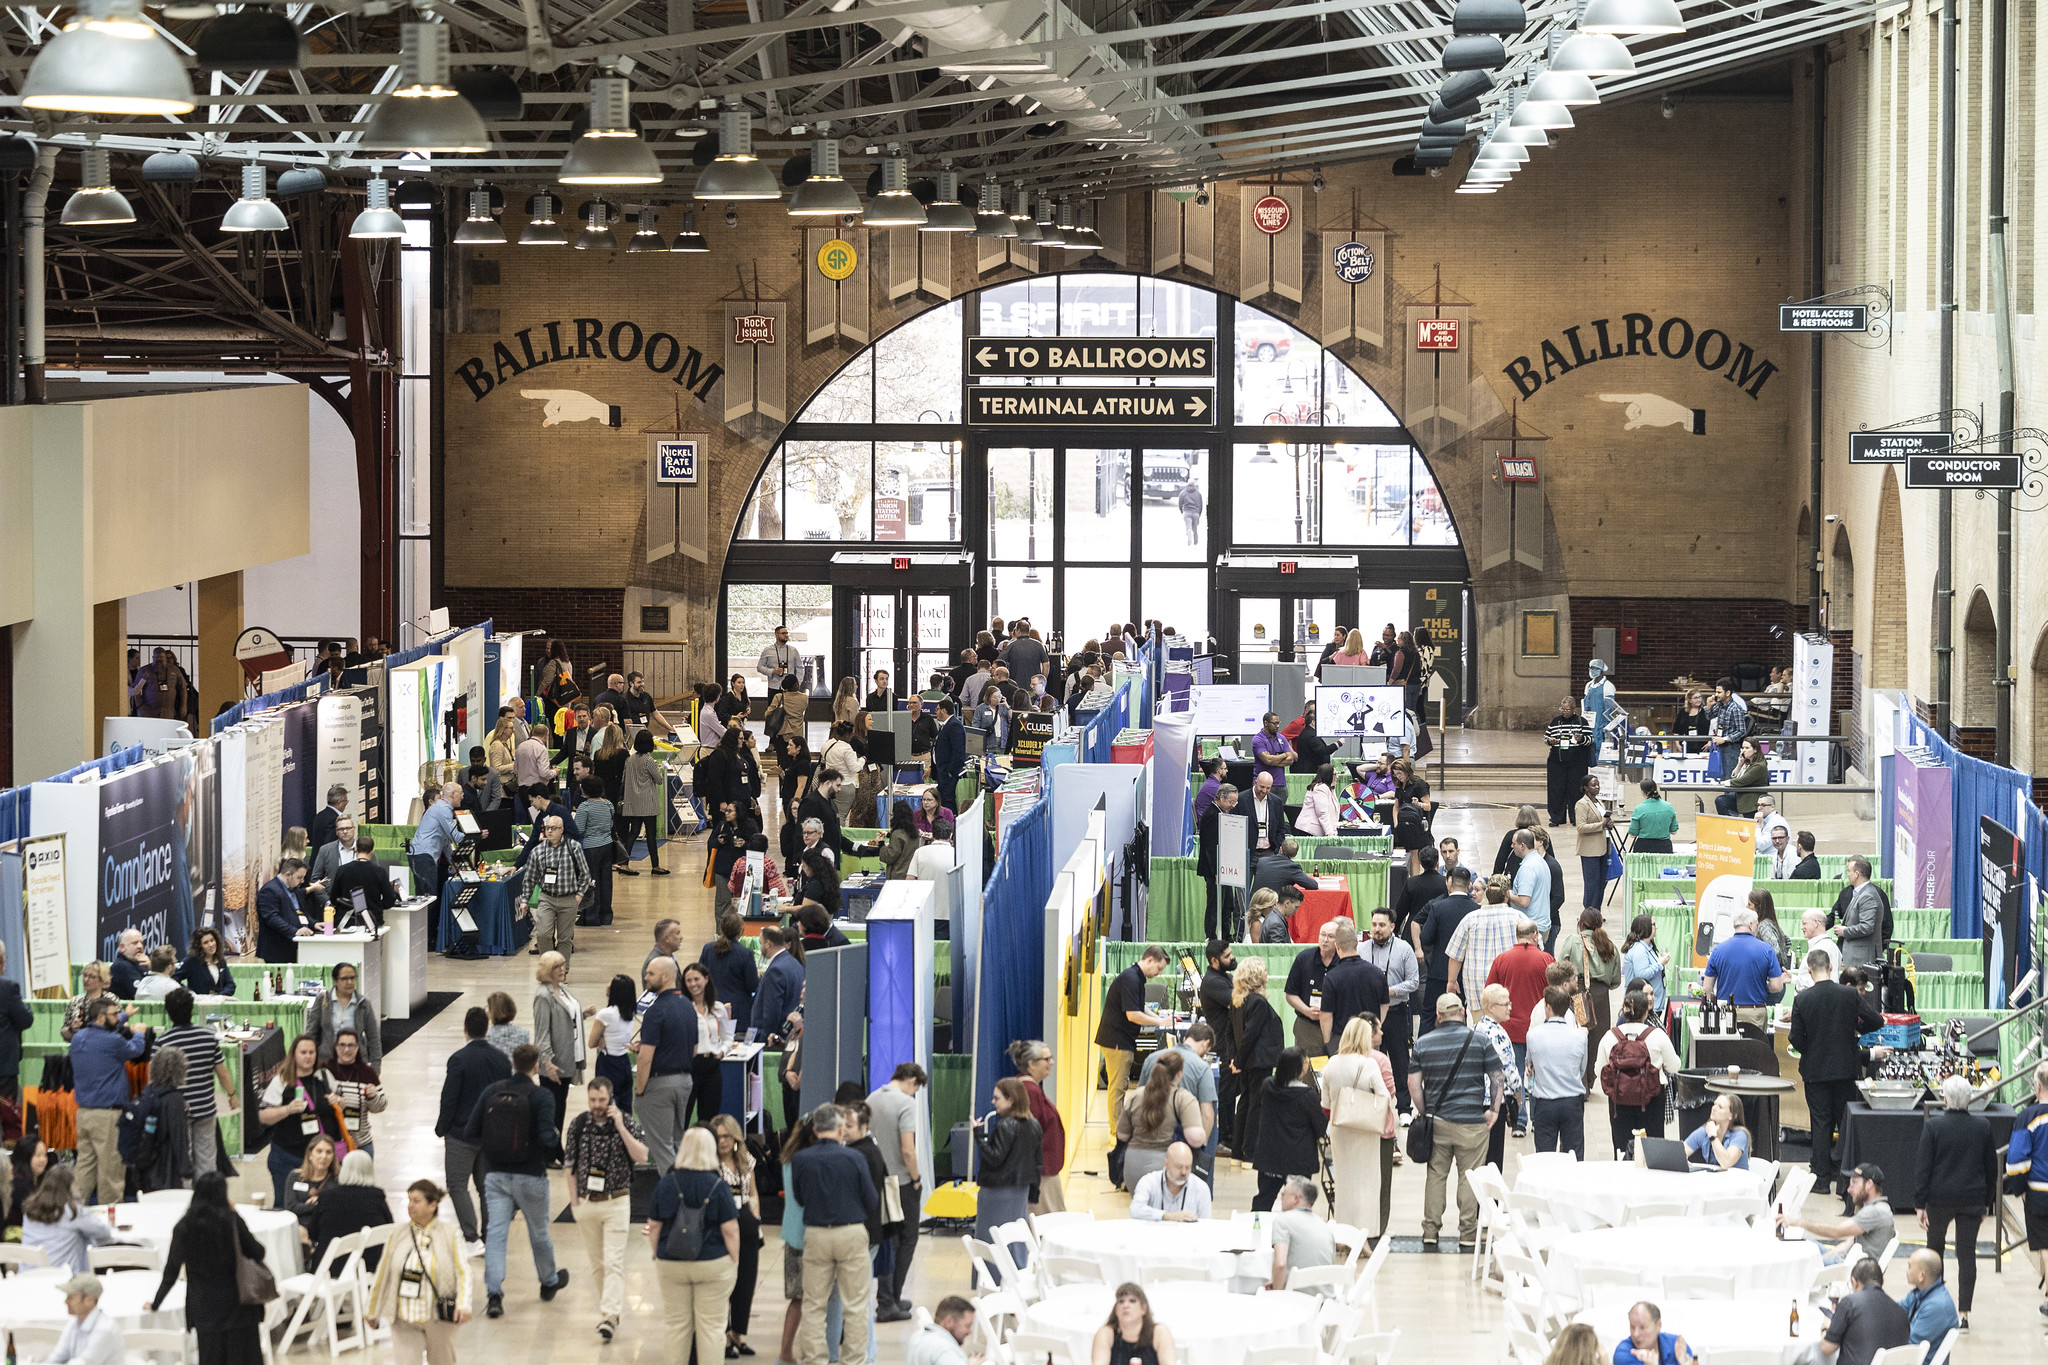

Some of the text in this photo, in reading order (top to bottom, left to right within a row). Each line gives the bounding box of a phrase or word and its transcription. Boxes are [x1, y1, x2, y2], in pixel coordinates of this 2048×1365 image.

[827, 249, 848, 270] SR
[1337, 247, 1365, 264] COTTON
[1349, 256, 1370, 267] BELT
[1344, 266, 1369, 280] ROUTE
[1010, 302, 1136, 326] SPIRIT
[1792, 310, 1854, 318] HOTEL ACCESS
[1792, 319, 1854, 327] & RESTROOMS
[742, 328, 768, 337] Island
[1420, 322, 1456, 342] MOBILE
[454, 318, 725, 403] BALLROOM
[1005, 347, 1206, 369] TO BALLROOMS
[1502, 313, 1780, 402] BALLROOM
[979, 397, 1175, 415] TERMINAL ATRIUM
[1880, 438, 1922, 447] STATION
[662, 446, 692, 457] NICKEL
[1864, 448, 1904, 458] MASTER
[668, 466, 693, 476] ROAD
[1504, 462, 1534, 476] WABASH
[1927, 461, 2001, 471] CONDUCTOR
[1946, 473, 1982, 483] ROOM
[894, 557, 909, 569] EXIT
[1280, 562, 1296, 573] EXIT
[1422, 618, 1450, 628] THE
[1019, 719, 1053, 735] XCLUDE
[1017, 740, 1038, 749] XCLUDER
[38, 850, 60, 862] AXIO
[1720, 854, 1729, 862] Not
[105, 840, 172, 909] Compliance
[1220, 866, 1238, 876] QIMA
[1926, 850, 1936, 909] WHEREFOUR
[141, 909, 169, 955] easy.
